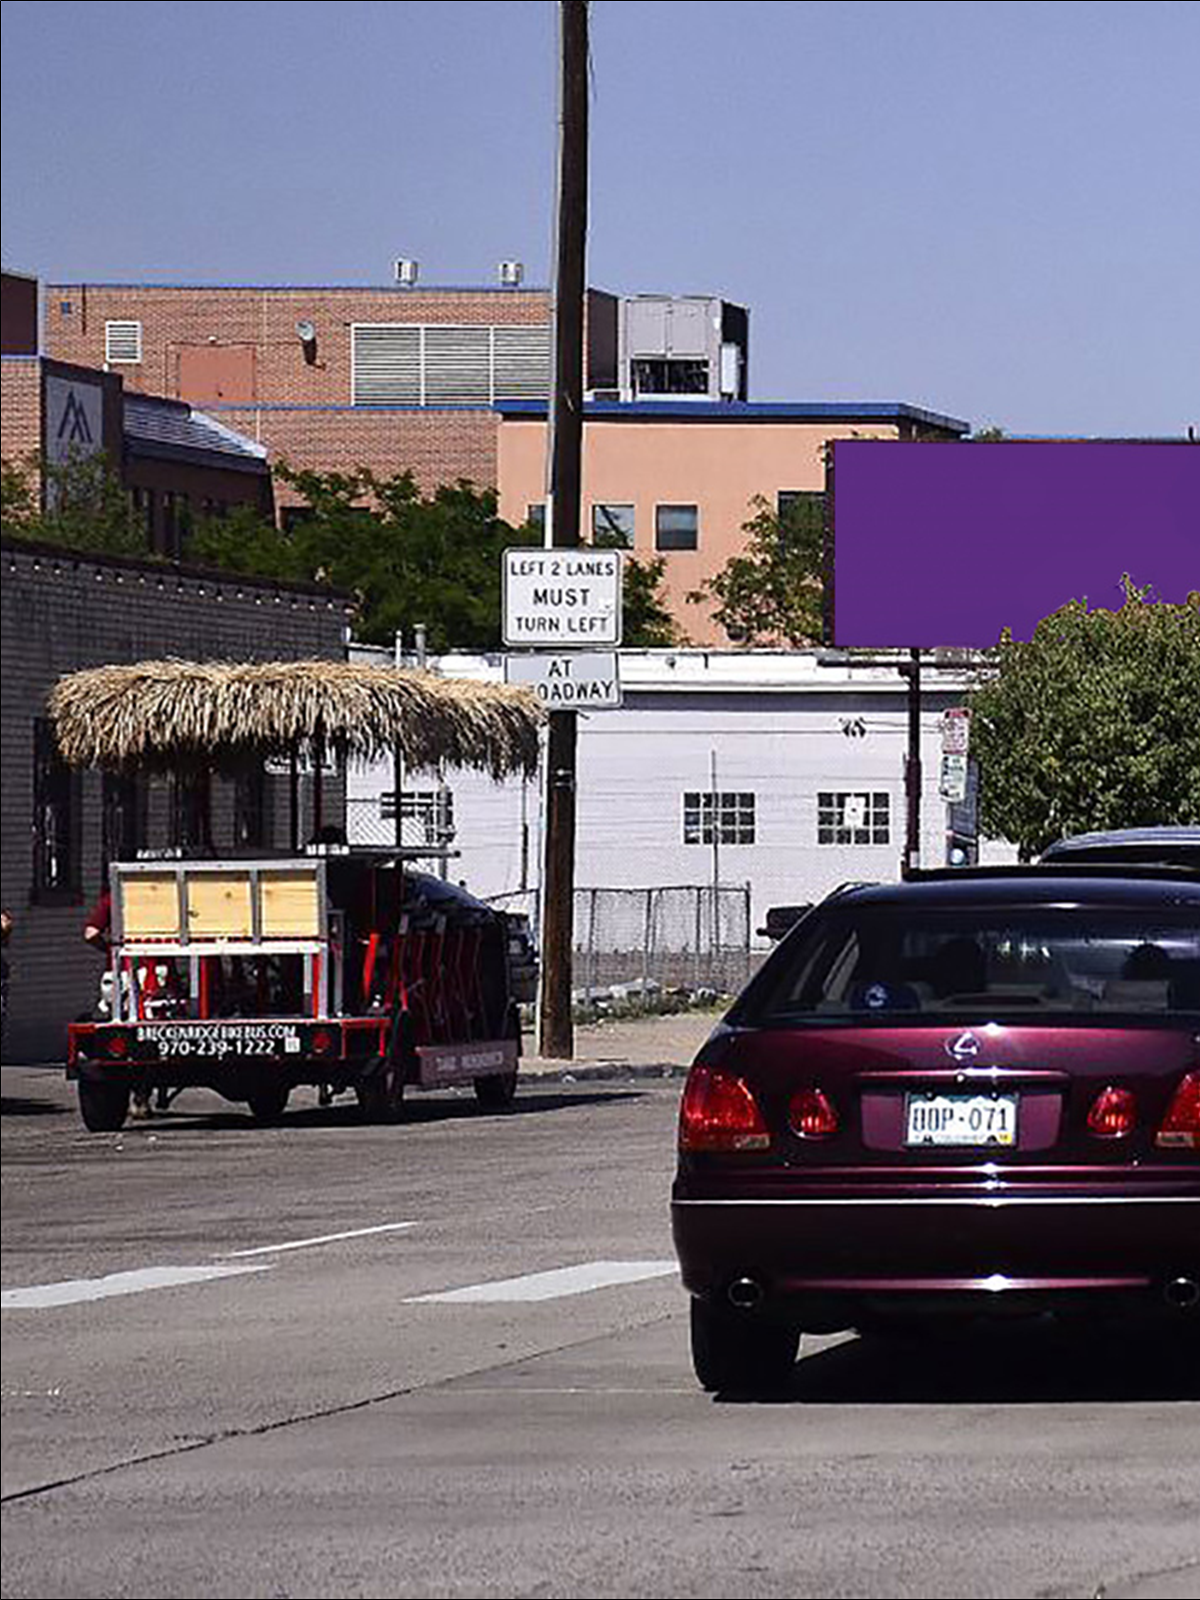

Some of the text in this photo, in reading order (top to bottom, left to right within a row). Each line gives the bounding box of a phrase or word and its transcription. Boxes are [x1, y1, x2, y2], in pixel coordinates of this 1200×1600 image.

[511, 561, 615, 577] LEFT 2 LANES
[533, 588, 590, 607] MUST
[516, 617, 608, 633] TURN LEFT
[548, 660, 572, 677] AT
[530, 681, 613, 700] OADWAY
[157, 1040, 276, 1056] 970-239-1222
